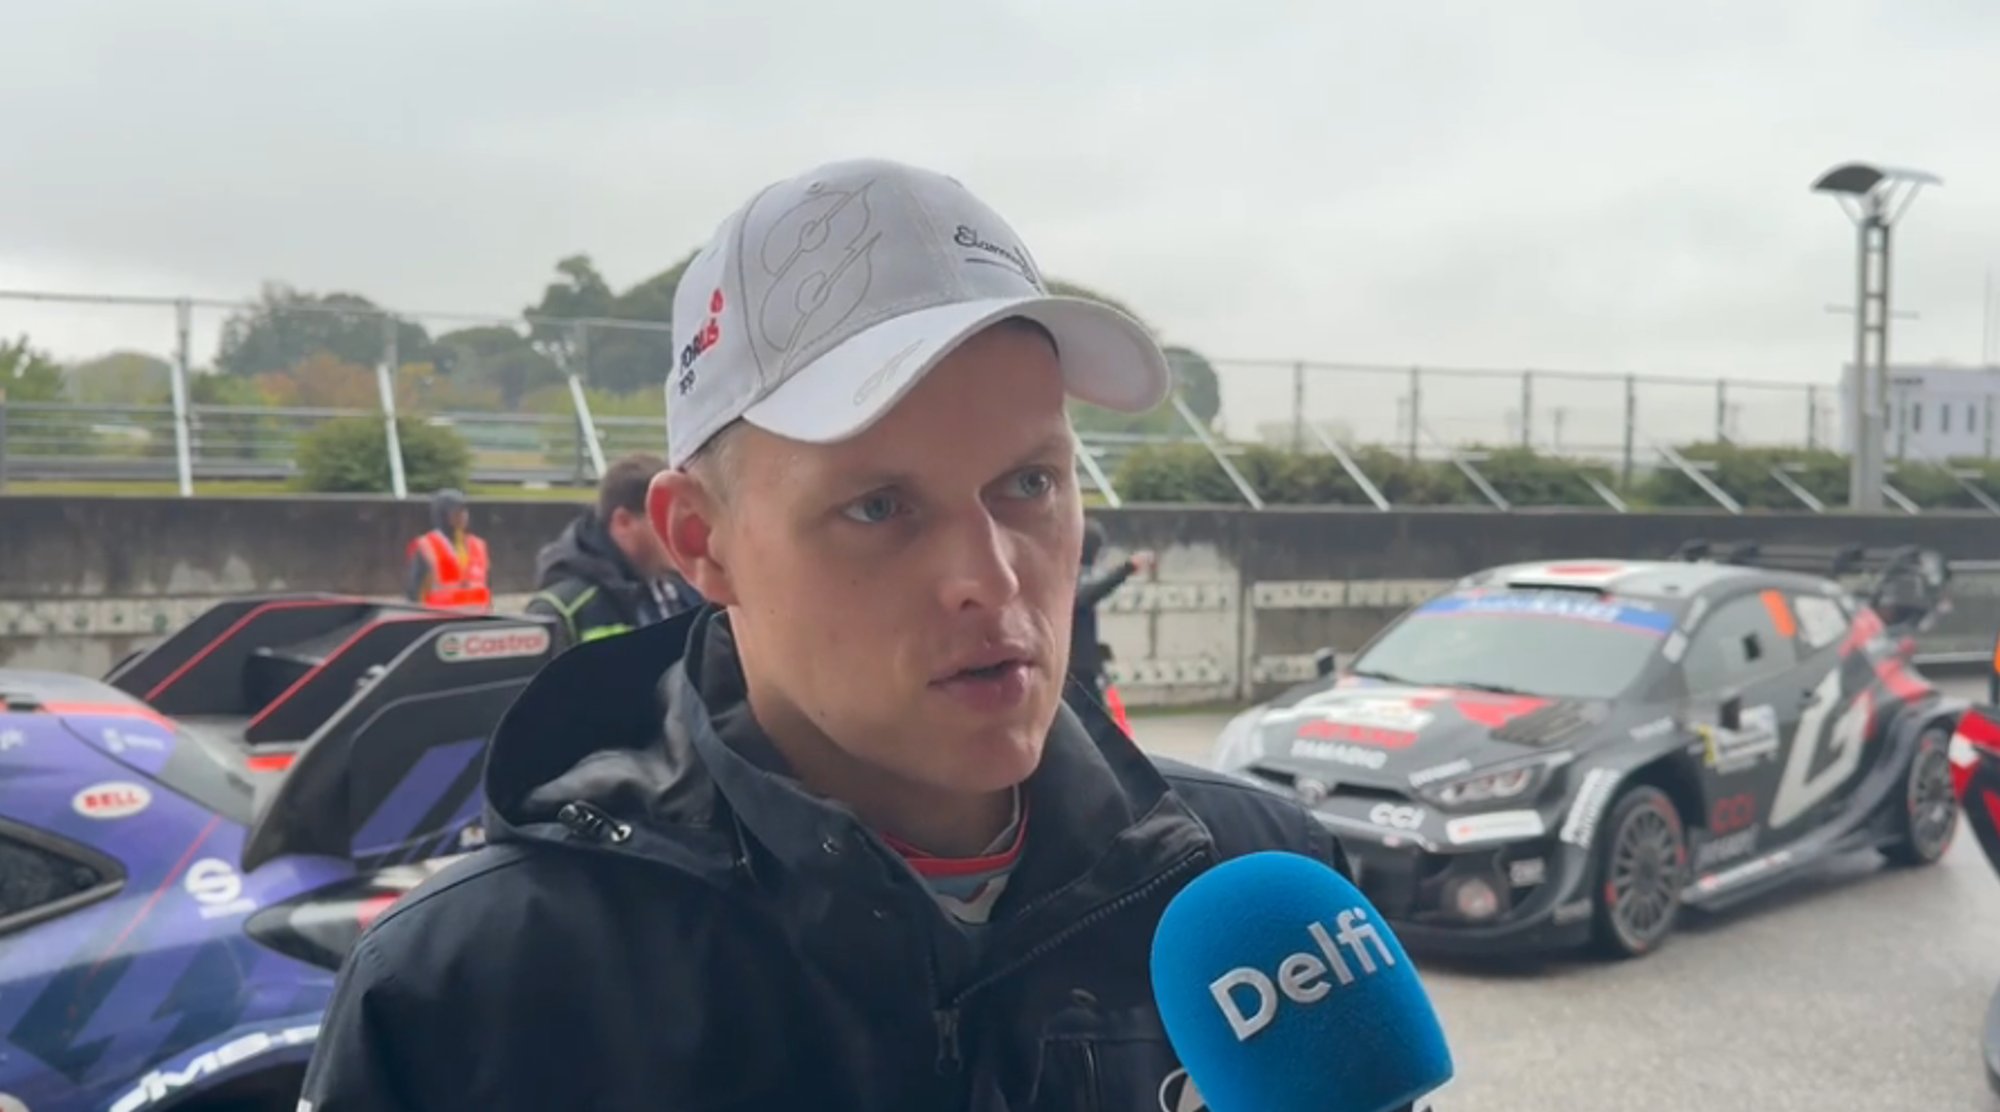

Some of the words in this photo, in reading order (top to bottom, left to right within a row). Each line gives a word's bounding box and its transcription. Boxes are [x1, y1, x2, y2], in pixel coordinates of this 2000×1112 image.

[465, 632, 546, 657] Castrol
[84, 790, 140, 812] BELL
[1209, 906, 1397, 1041] Delfi
